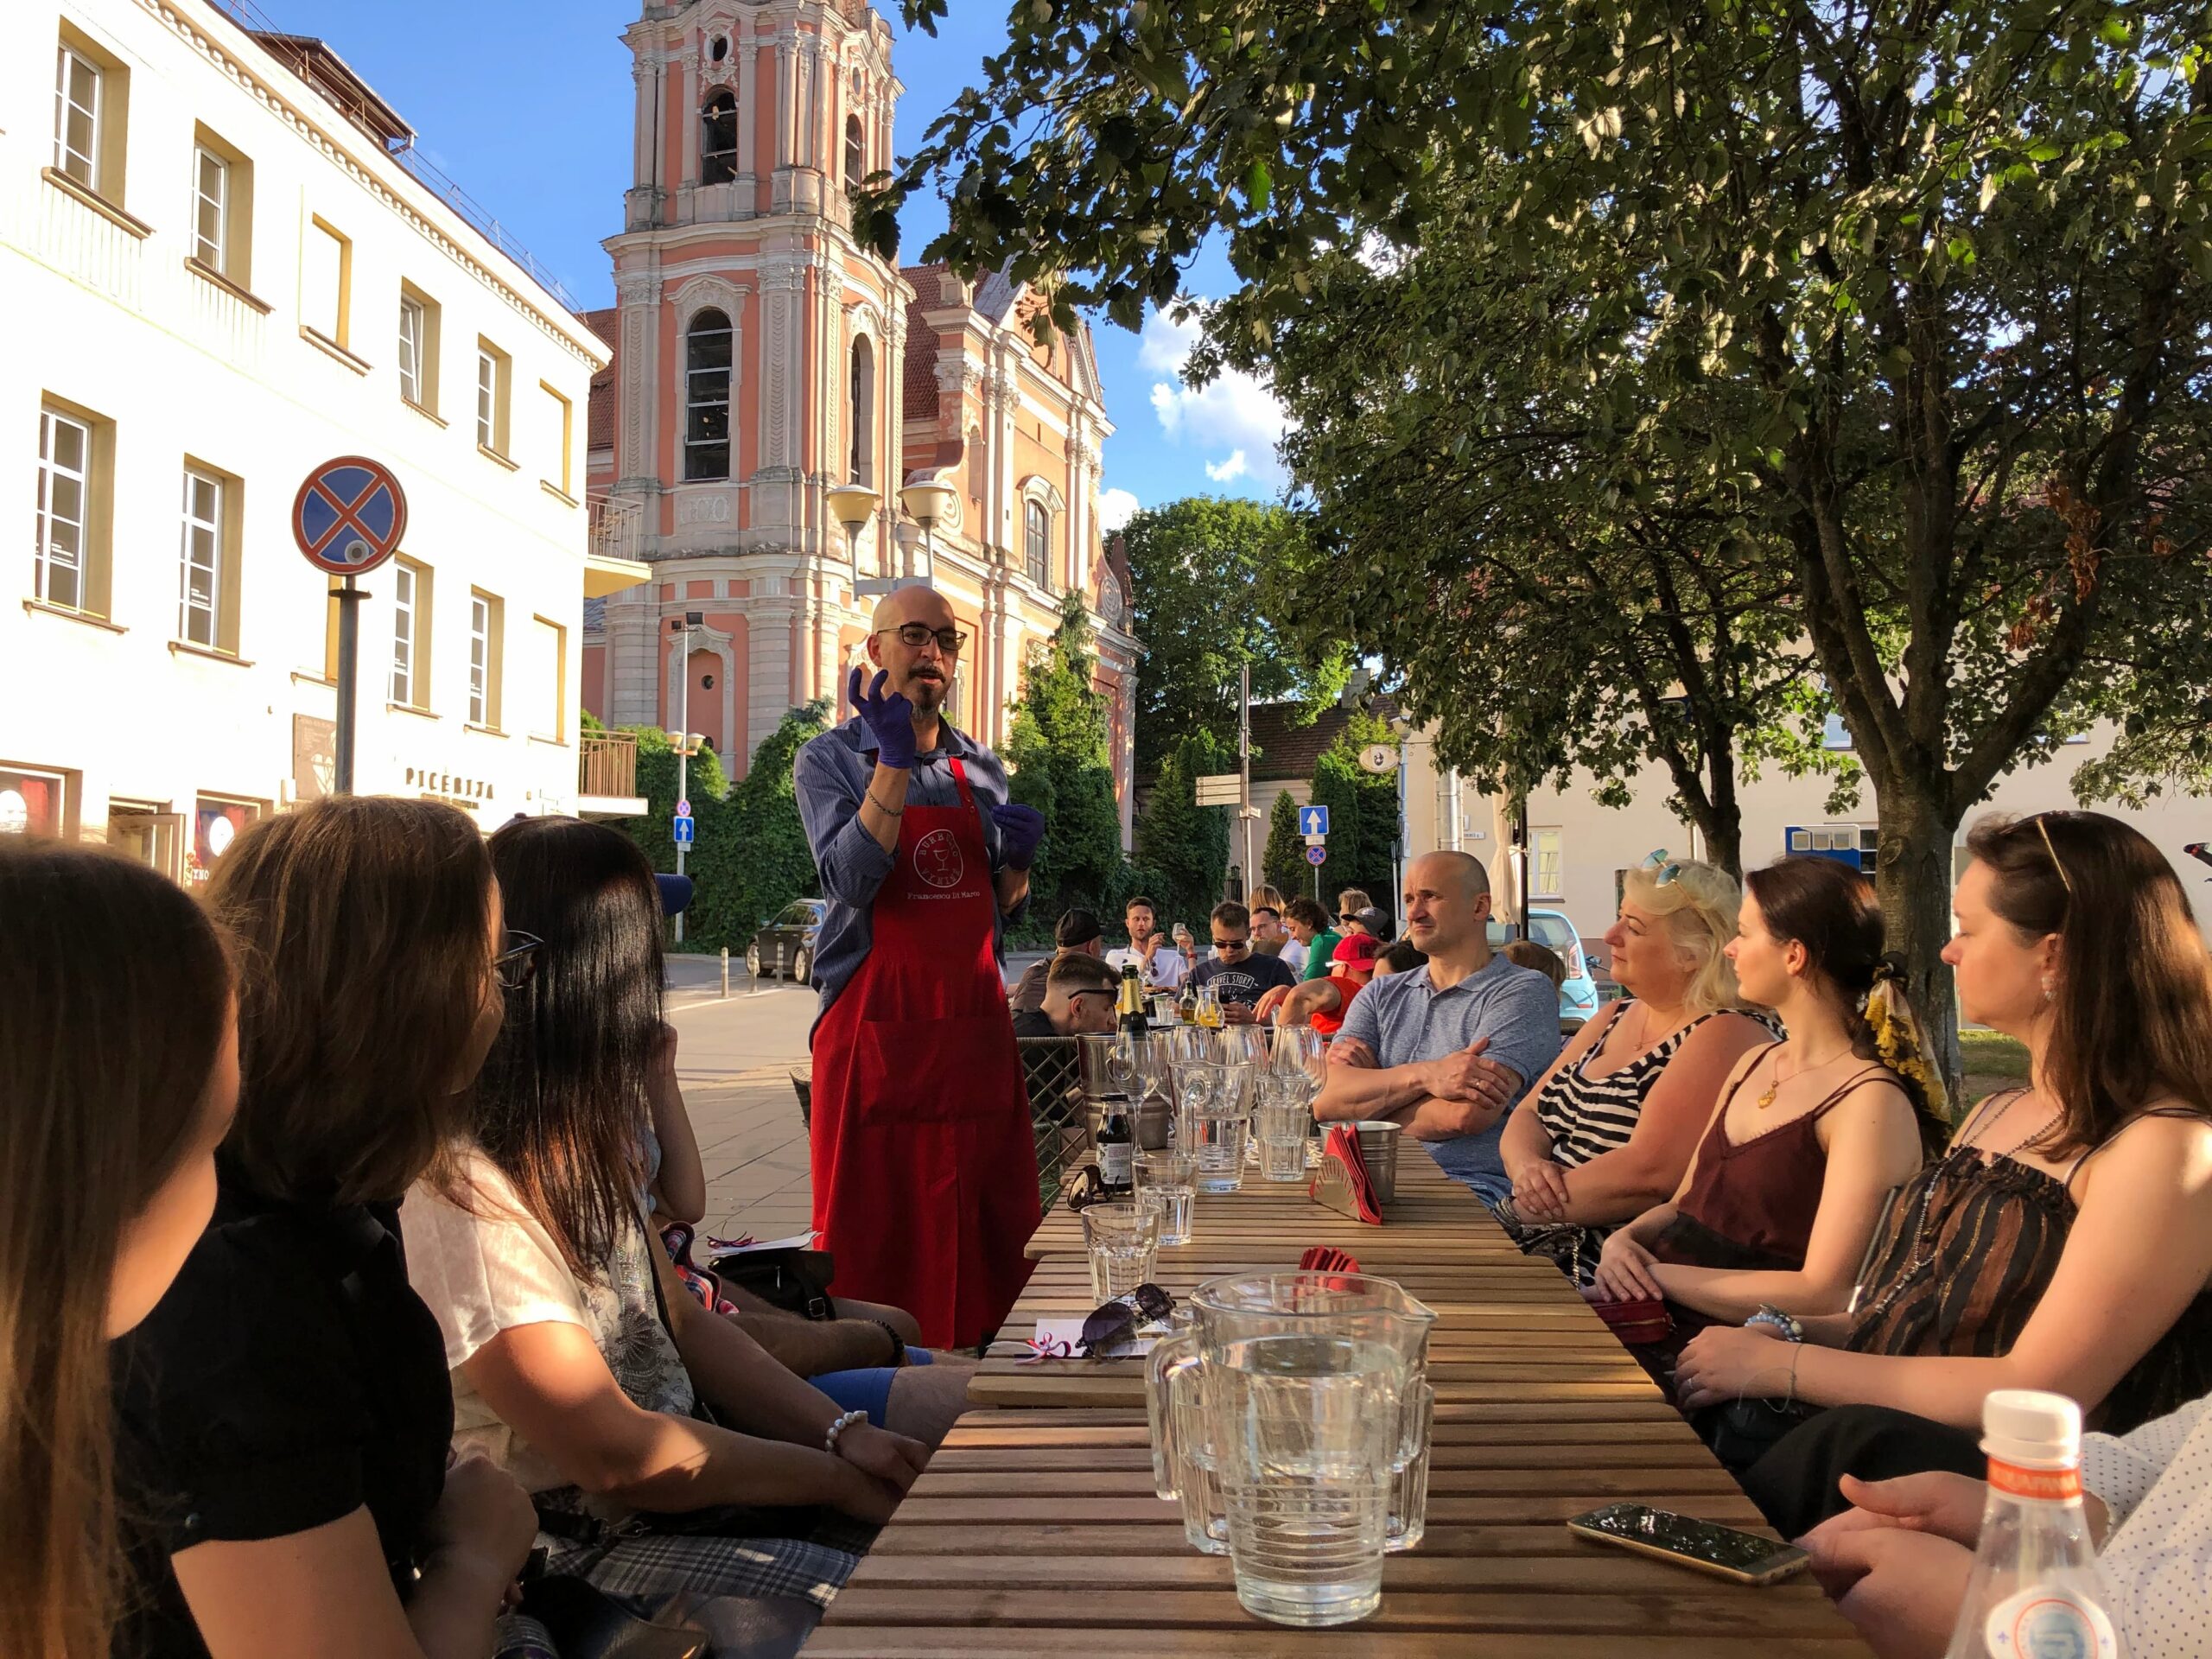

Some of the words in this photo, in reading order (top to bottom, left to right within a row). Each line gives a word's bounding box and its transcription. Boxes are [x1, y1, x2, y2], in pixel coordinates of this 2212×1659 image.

[406, 767, 493, 799] PICERIJA
[1210, 976, 1229, 985] TRAVEL
[1232, 975, 1251, 985] STORY
